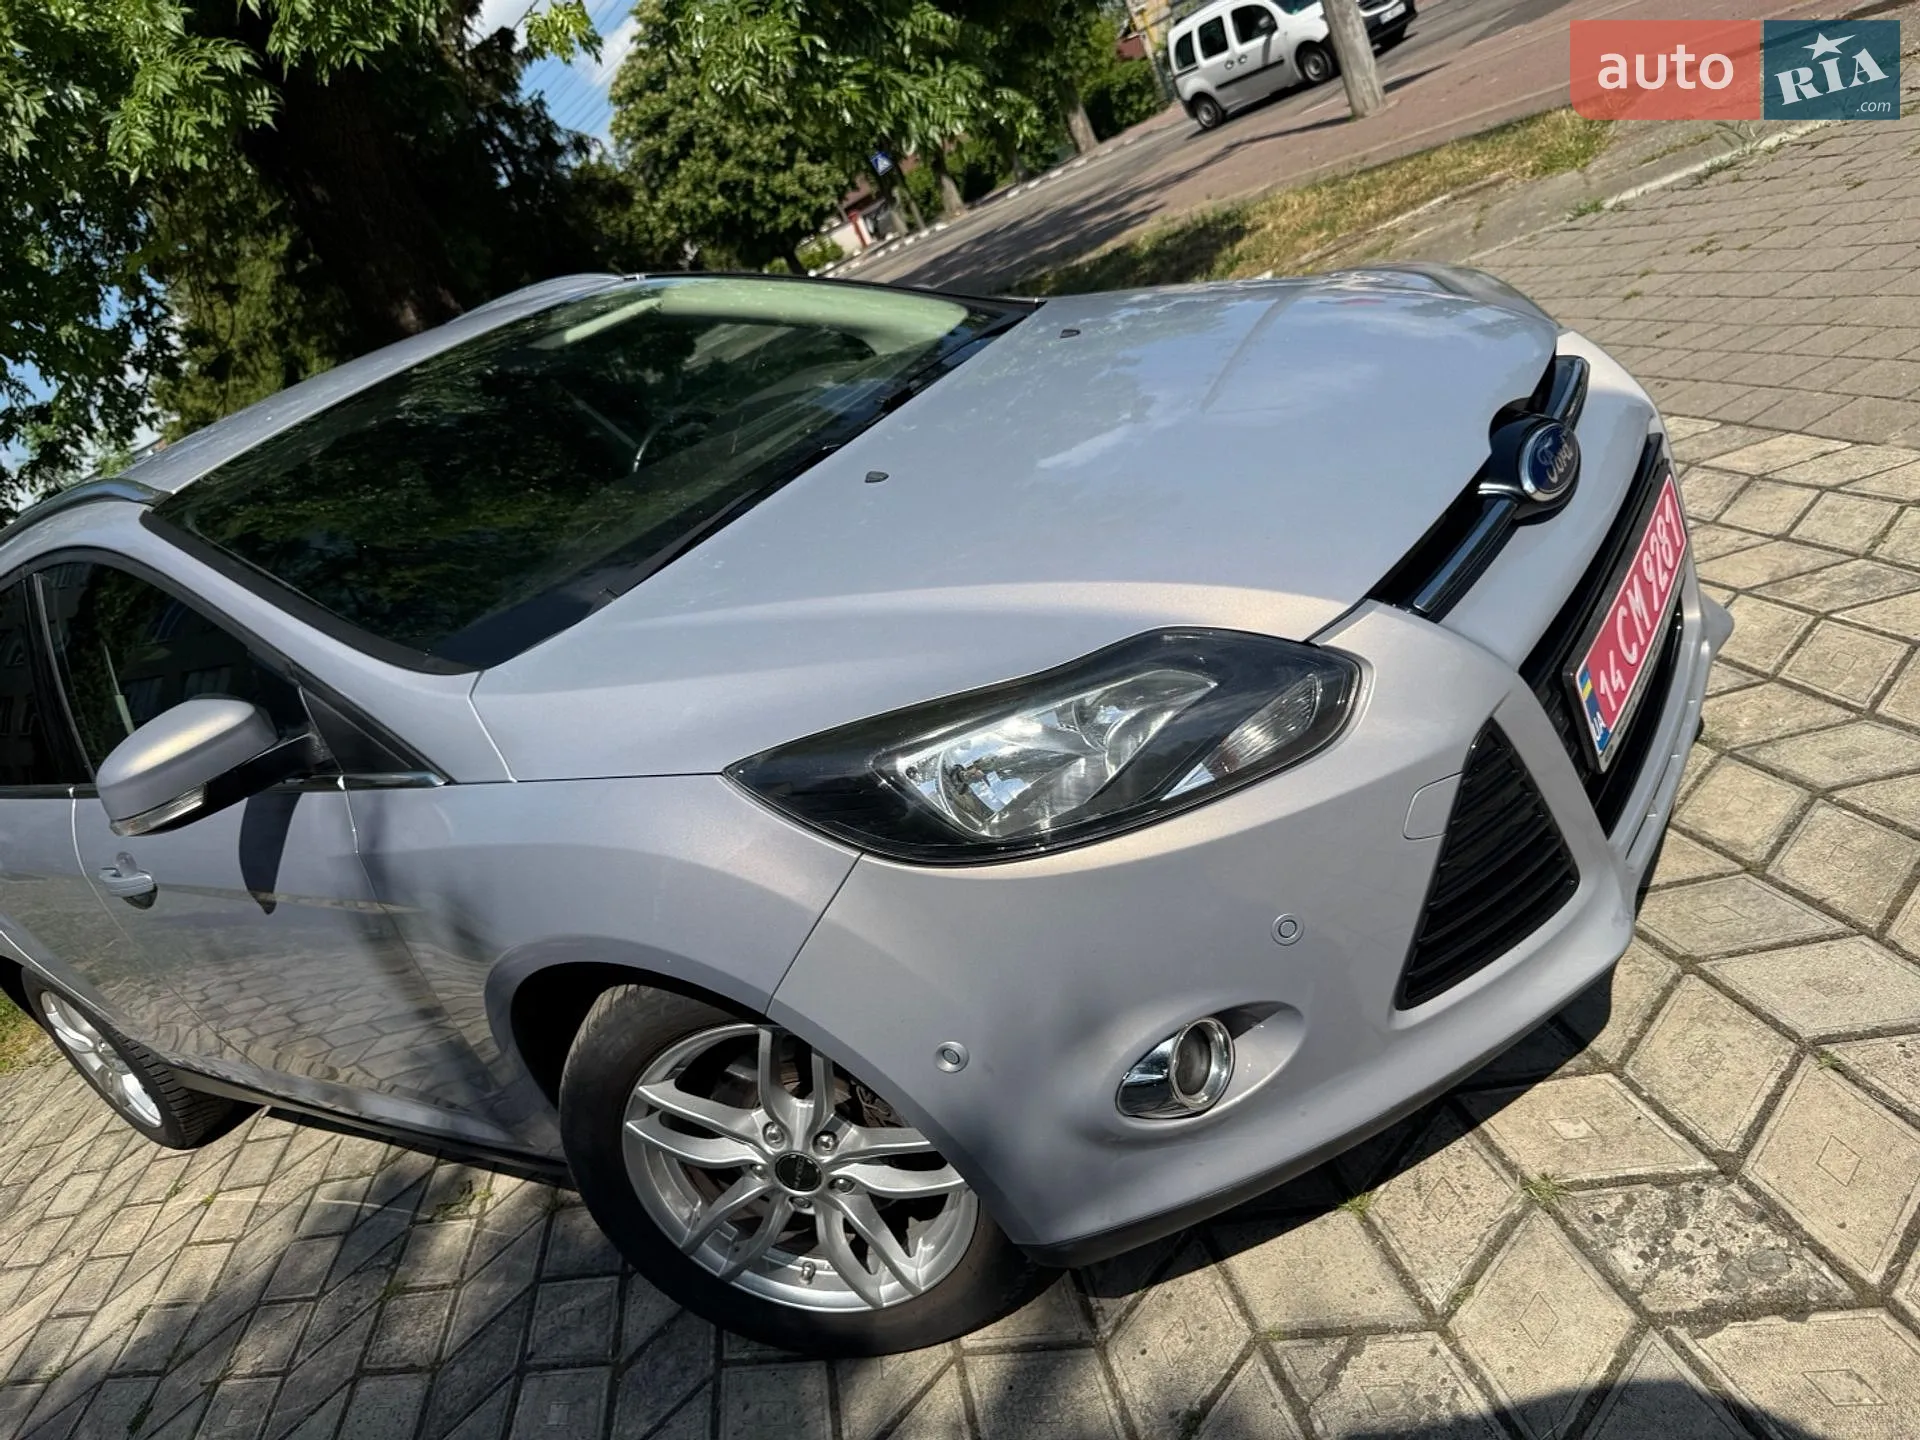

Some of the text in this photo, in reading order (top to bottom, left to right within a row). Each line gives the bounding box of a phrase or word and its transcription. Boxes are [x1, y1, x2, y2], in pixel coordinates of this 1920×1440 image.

[1537, 432, 1574, 484] Ford
[1600, 650, 1626, 711] 14
[1616, 574, 1651, 664] CM
[1643, 494, 1681, 612] 9281
